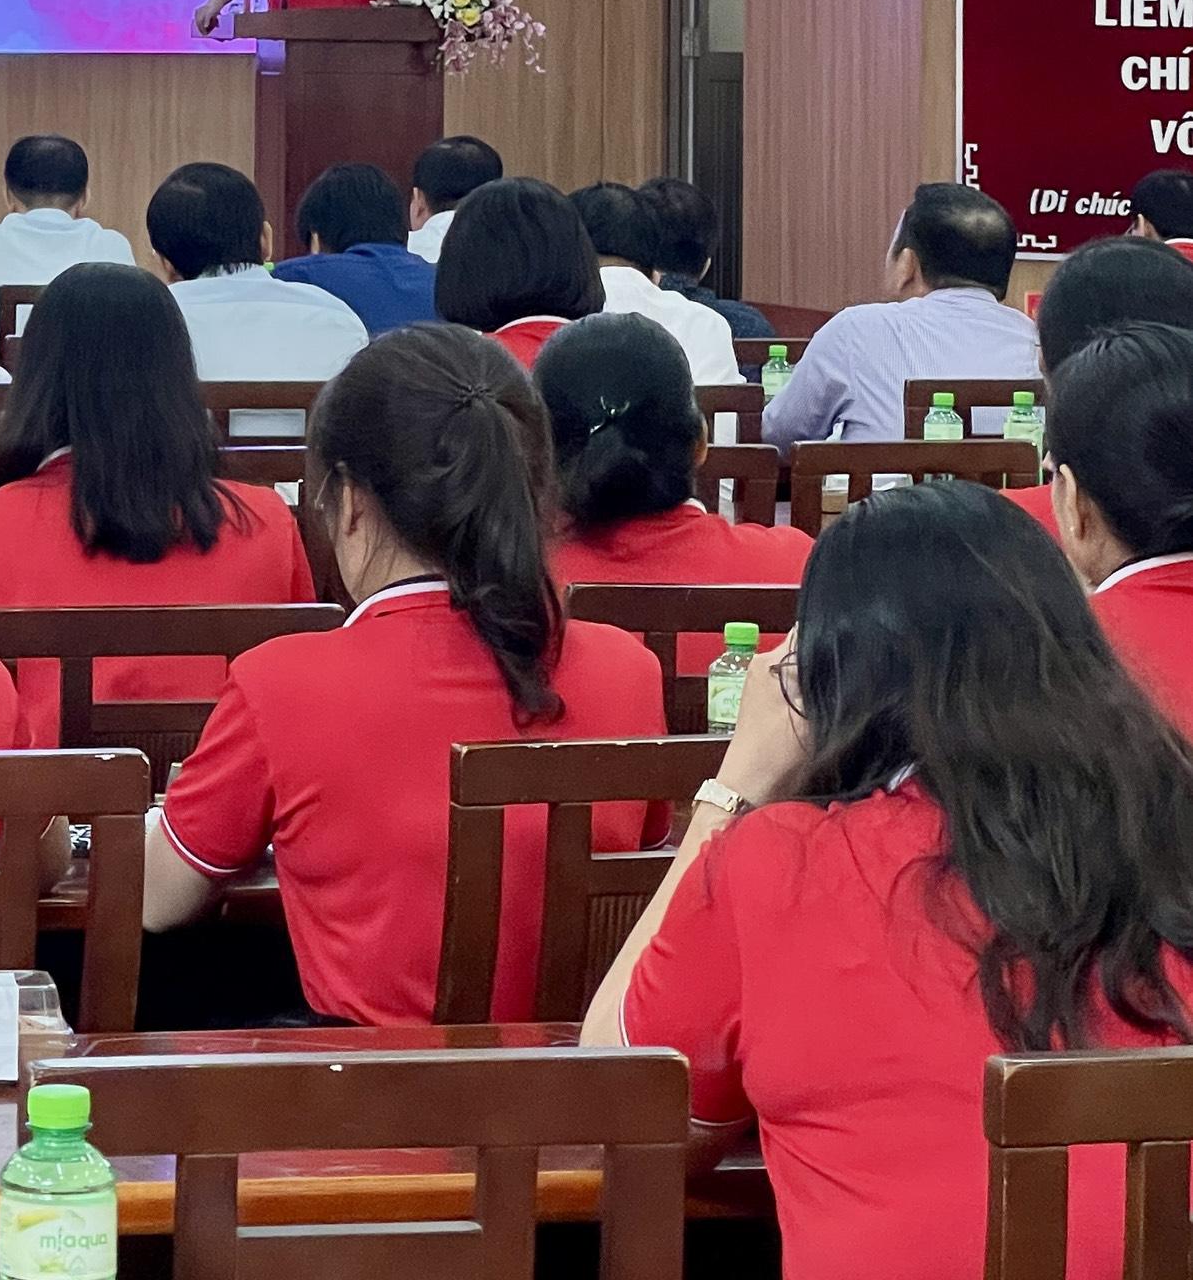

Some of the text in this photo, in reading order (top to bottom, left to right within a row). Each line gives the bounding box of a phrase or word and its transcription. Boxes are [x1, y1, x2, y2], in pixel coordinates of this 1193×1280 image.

[1120, 46, 1193, 92] CHÍ
[1029, 188, 1132, 217] (Di chúc
